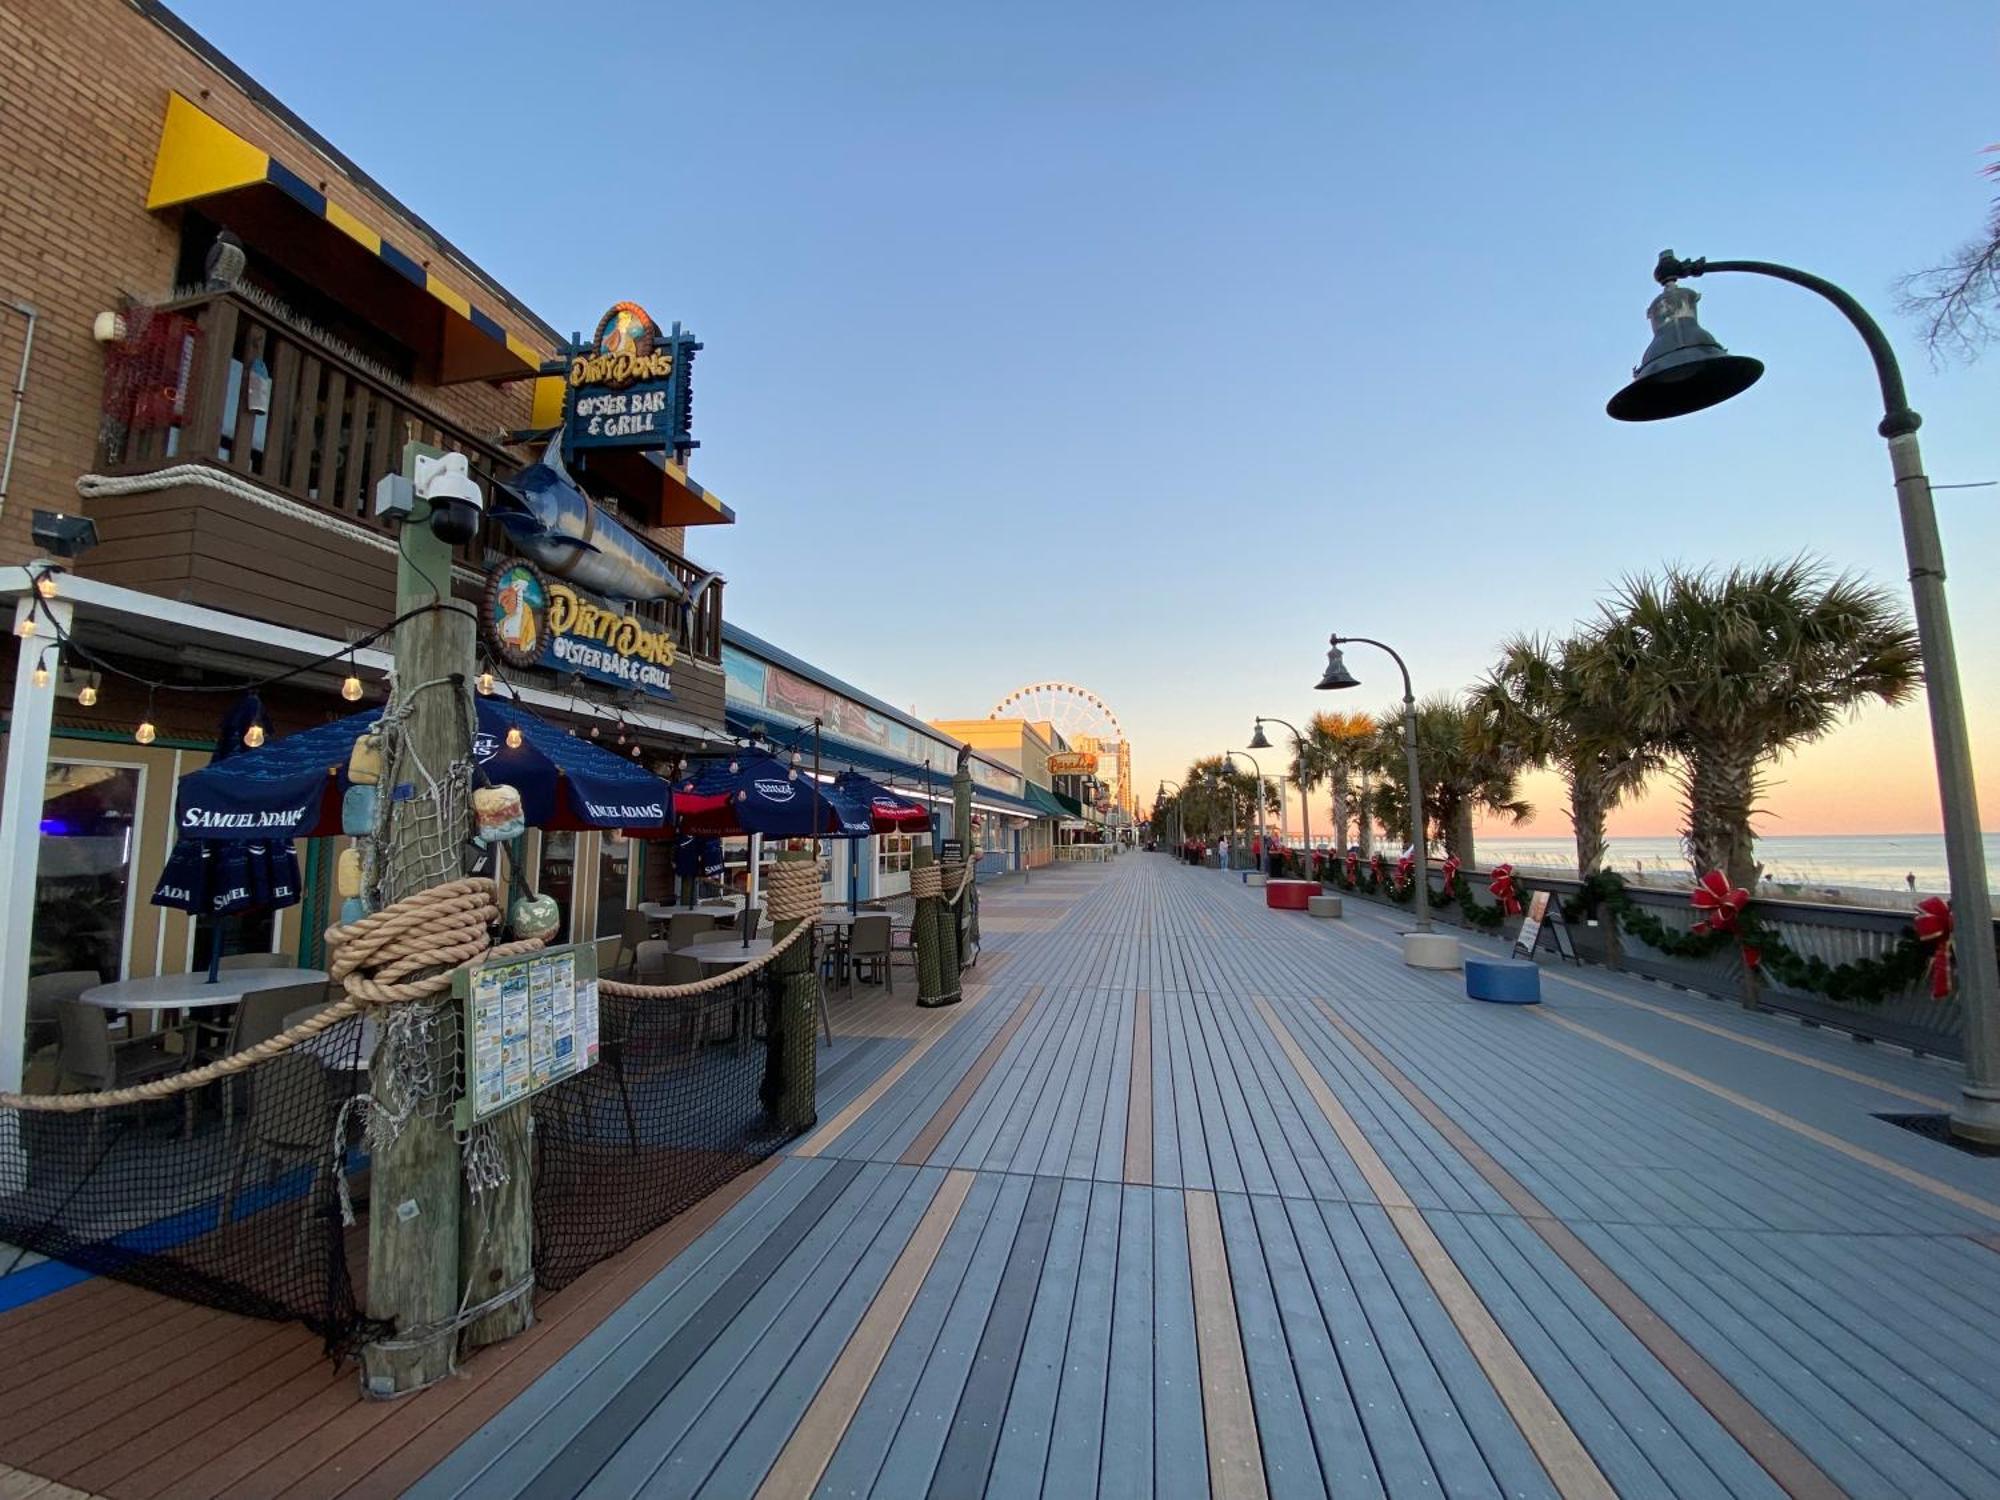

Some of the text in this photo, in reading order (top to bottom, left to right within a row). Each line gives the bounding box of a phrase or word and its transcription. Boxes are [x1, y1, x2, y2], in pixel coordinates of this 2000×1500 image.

[576, 391, 666, 417] OYSTER BAR
[587, 413, 654, 437] & GRILL
[553, 636, 671, 690] OYSTER BAR & GRILL
[181, 807, 257, 828] SAMUEL
[620, 803, 664, 818] ADAMS
